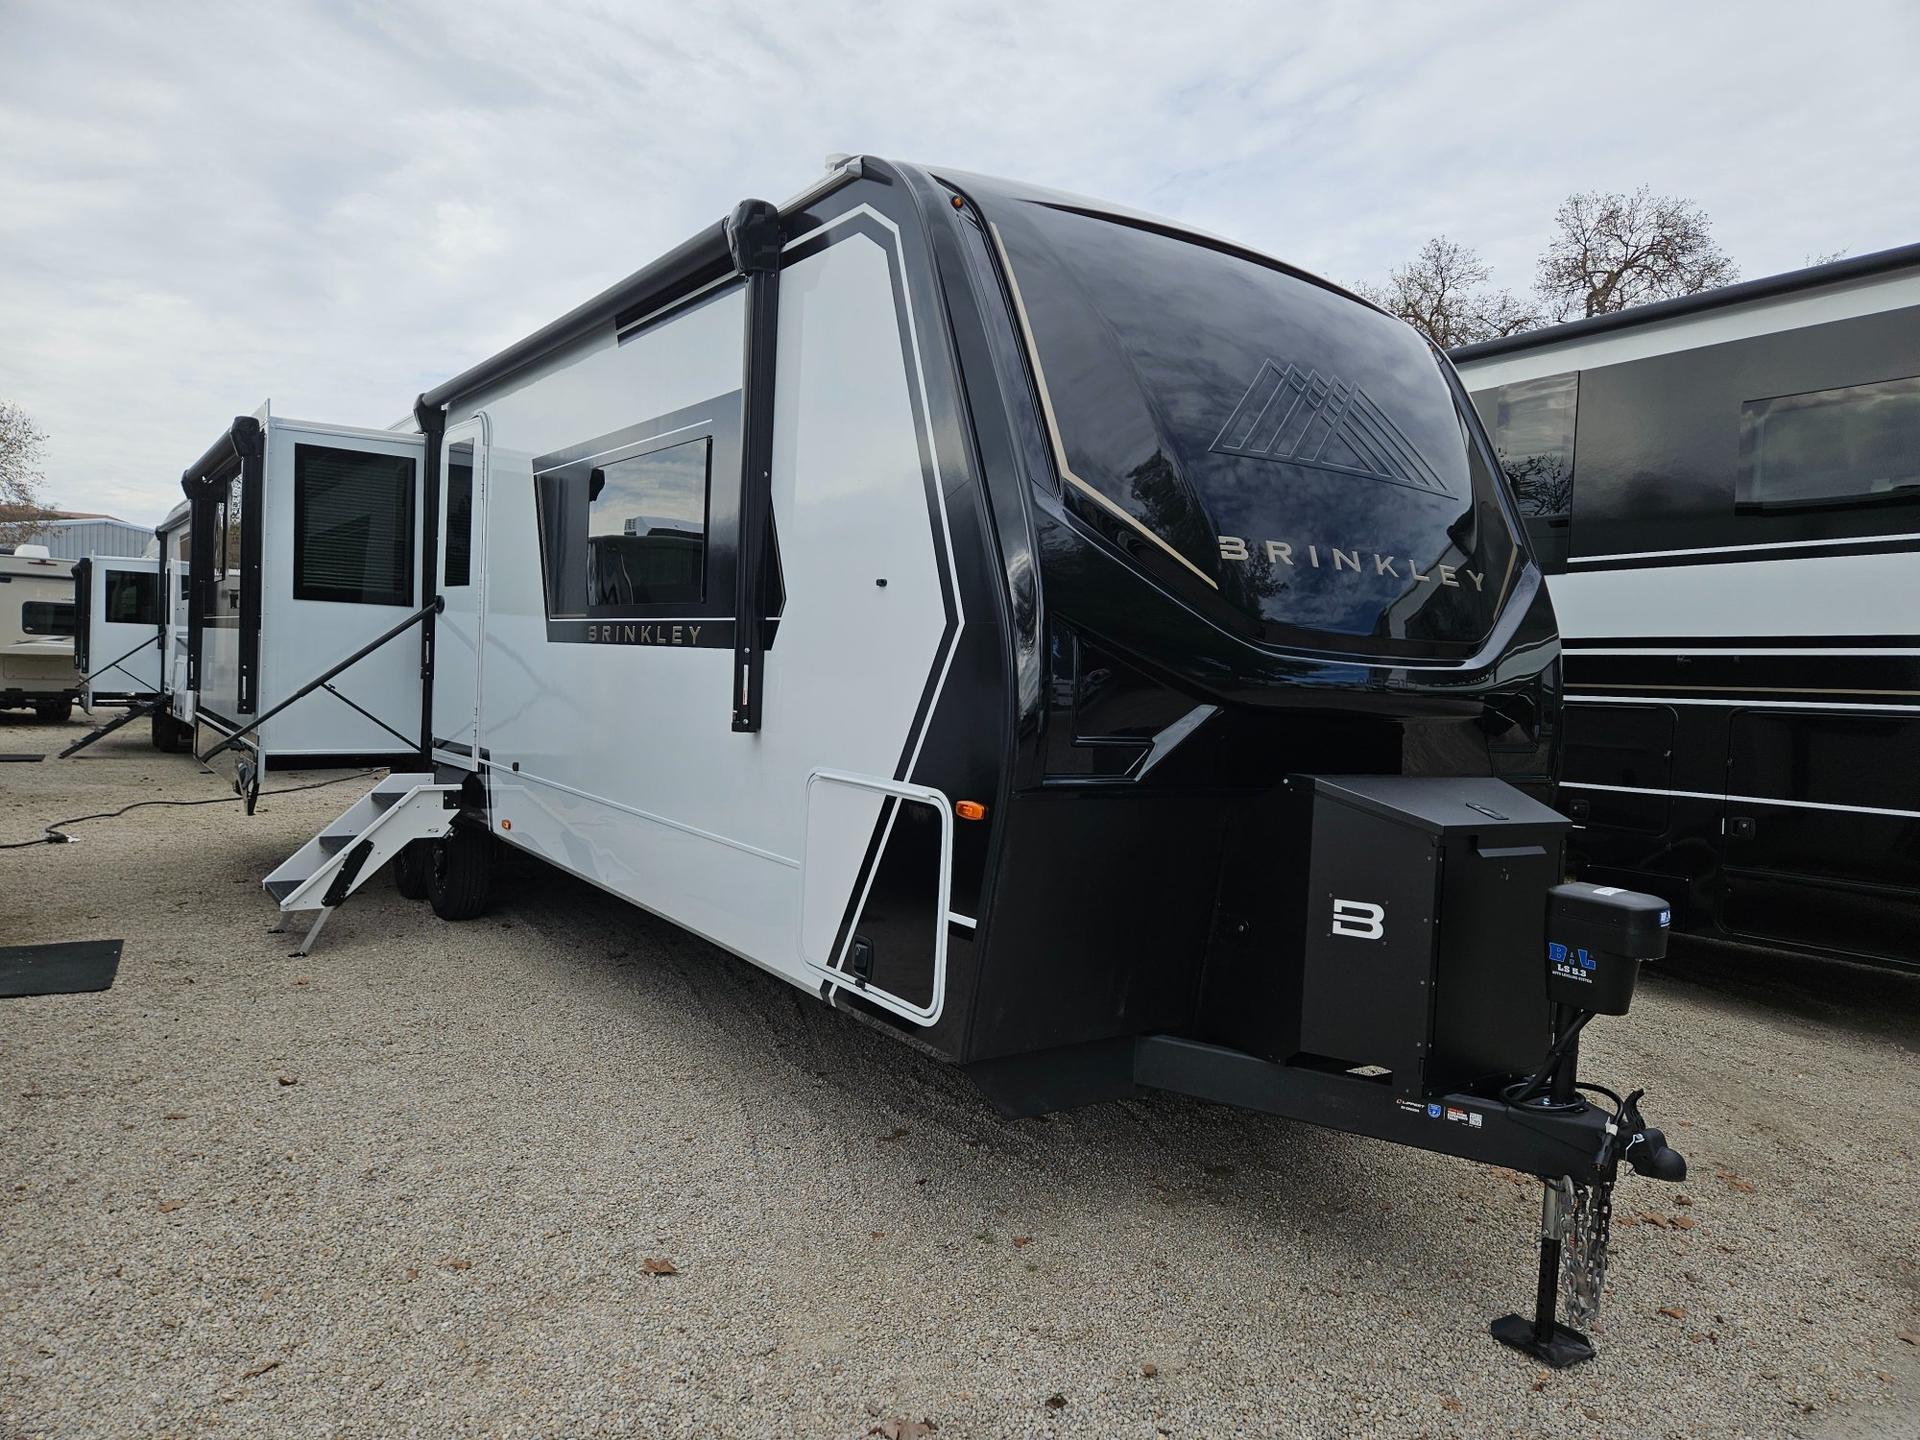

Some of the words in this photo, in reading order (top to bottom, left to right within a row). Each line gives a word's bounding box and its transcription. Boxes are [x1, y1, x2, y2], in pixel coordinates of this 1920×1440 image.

[1217, 535, 1485, 592] BRINKLEY
[588, 625, 702, 645] BRINKLEY
[1558, 964, 1570, 973] LS
[1571, 968, 1587, 977] 5.3
